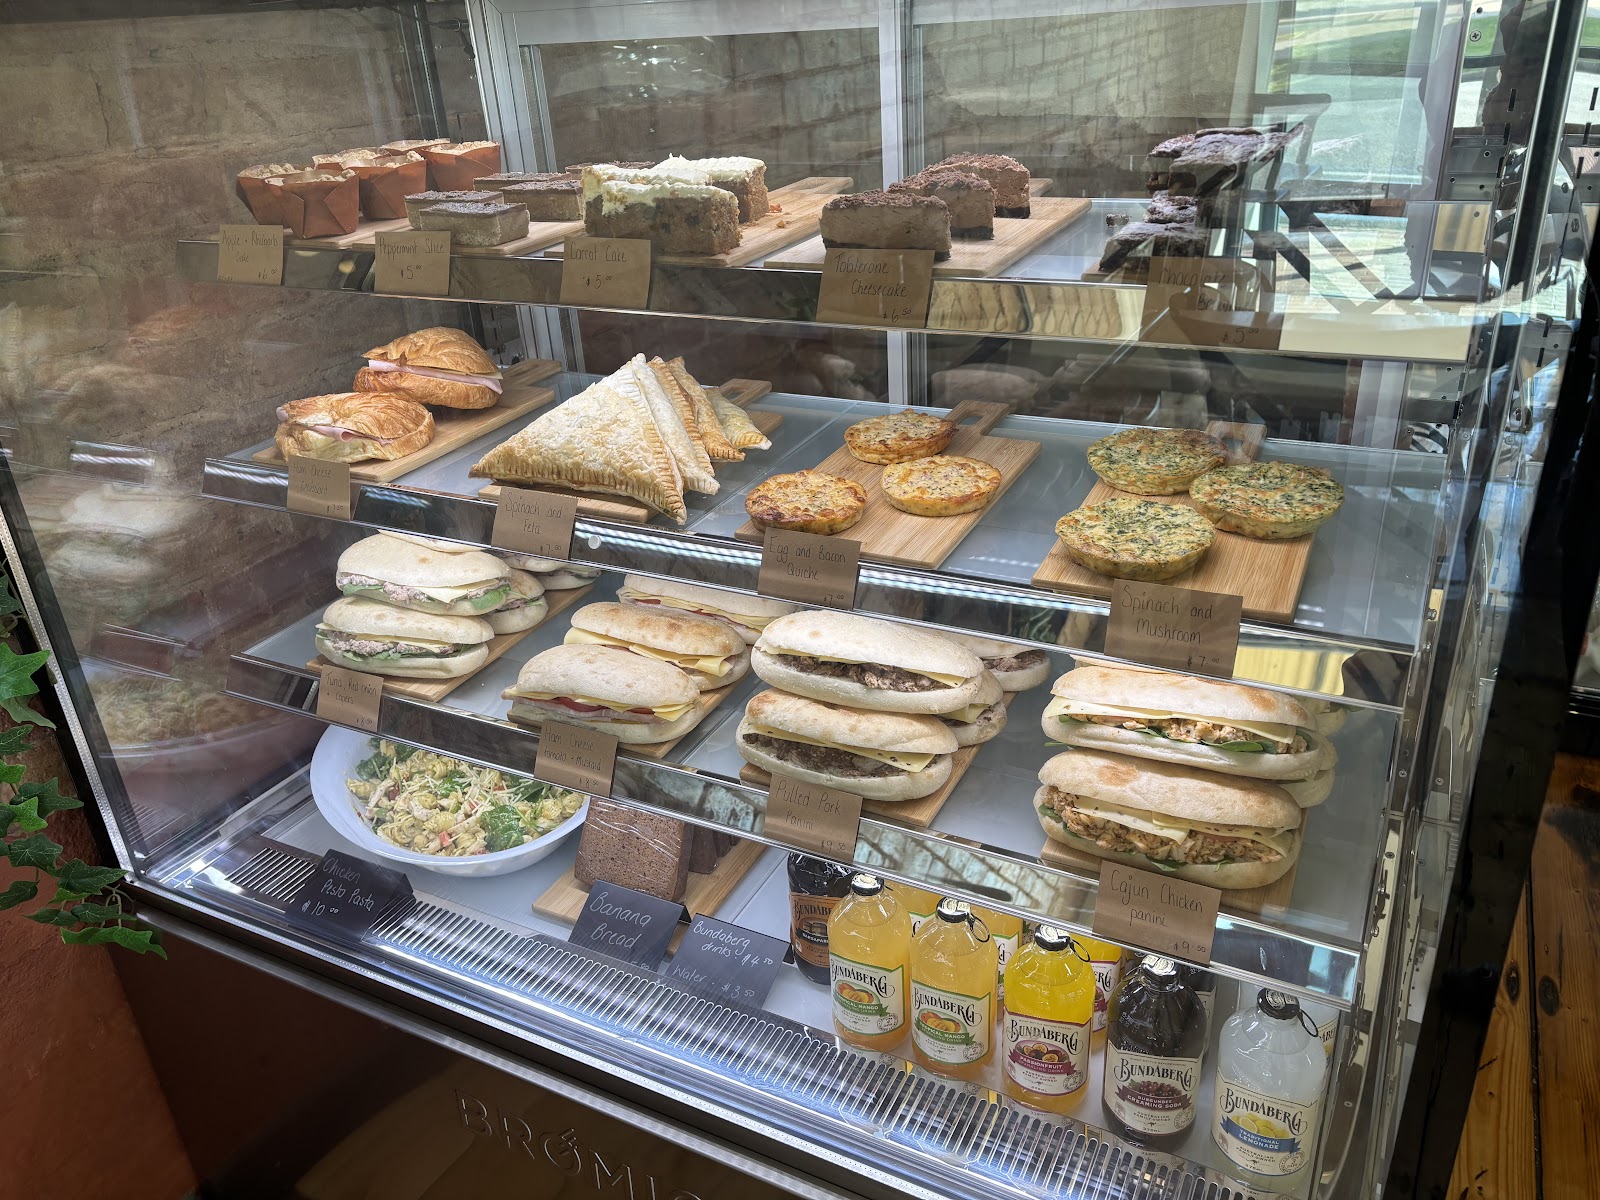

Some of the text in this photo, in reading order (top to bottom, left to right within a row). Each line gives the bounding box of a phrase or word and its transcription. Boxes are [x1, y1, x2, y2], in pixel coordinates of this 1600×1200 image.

[222, 230, 240, 252] Apple
[251, 230, 278, 247] Rhubarb
[379, 236, 445, 261] Peppermint Slice
[570, 241, 627, 263] Carrot Cake
[834, 251, 889, 274] Toblerone
[851, 278, 908, 297] Cheesecake
[293, 462, 332, 478] Ham Cheese
[300, 480, 329, 495] Croissant
[505, 491, 563, 518] Spinach and
[523, 518, 541, 535] Feta
[769, 535, 846, 564] Egg and Bacon
[787, 562, 819, 581] Quiche
[1121, 585, 1213, 619] Spinach and
[1136, 617, 1201, 645] Mushroom
[348, 677, 359, 692] Red
[544, 725, 594, 752] Ham Cheese
[775, 779, 841, 815] Pulled Pork
[785, 810, 814, 831] Panini
[322, 857, 361, 884] Chicken
[320, 879, 375, 911] Pesto Pasta
[1110, 869, 1203, 914] Cajun Chicken
[589, 891, 652, 928] Banana
[1129, 908, 1168, 927] panini
[590, 922, 643, 949] Bread
[693, 920, 751, 956] Bundaberg
[672, 964, 707, 983] Water
[831, 958, 895, 998] BUNDABERG
[912, 986, 982, 1027] BUNDABERG
[1006, 1019, 1084, 1055] BUNDABERG
[1020, 1057, 1063, 1069] PASSIONFRUIT
[1114, 1057, 1197, 1092] BUNDABERG
[1127, 1095, 1163, 1109] CREAMING
[1219, 1087, 1308, 1136] BUNDABERG
[456, 1088, 702, 1200] BROMI
[1239, 1129, 1280, 1145] TRADITIONAL
[1239, 1135, 1279, 1149] LEMONADE
